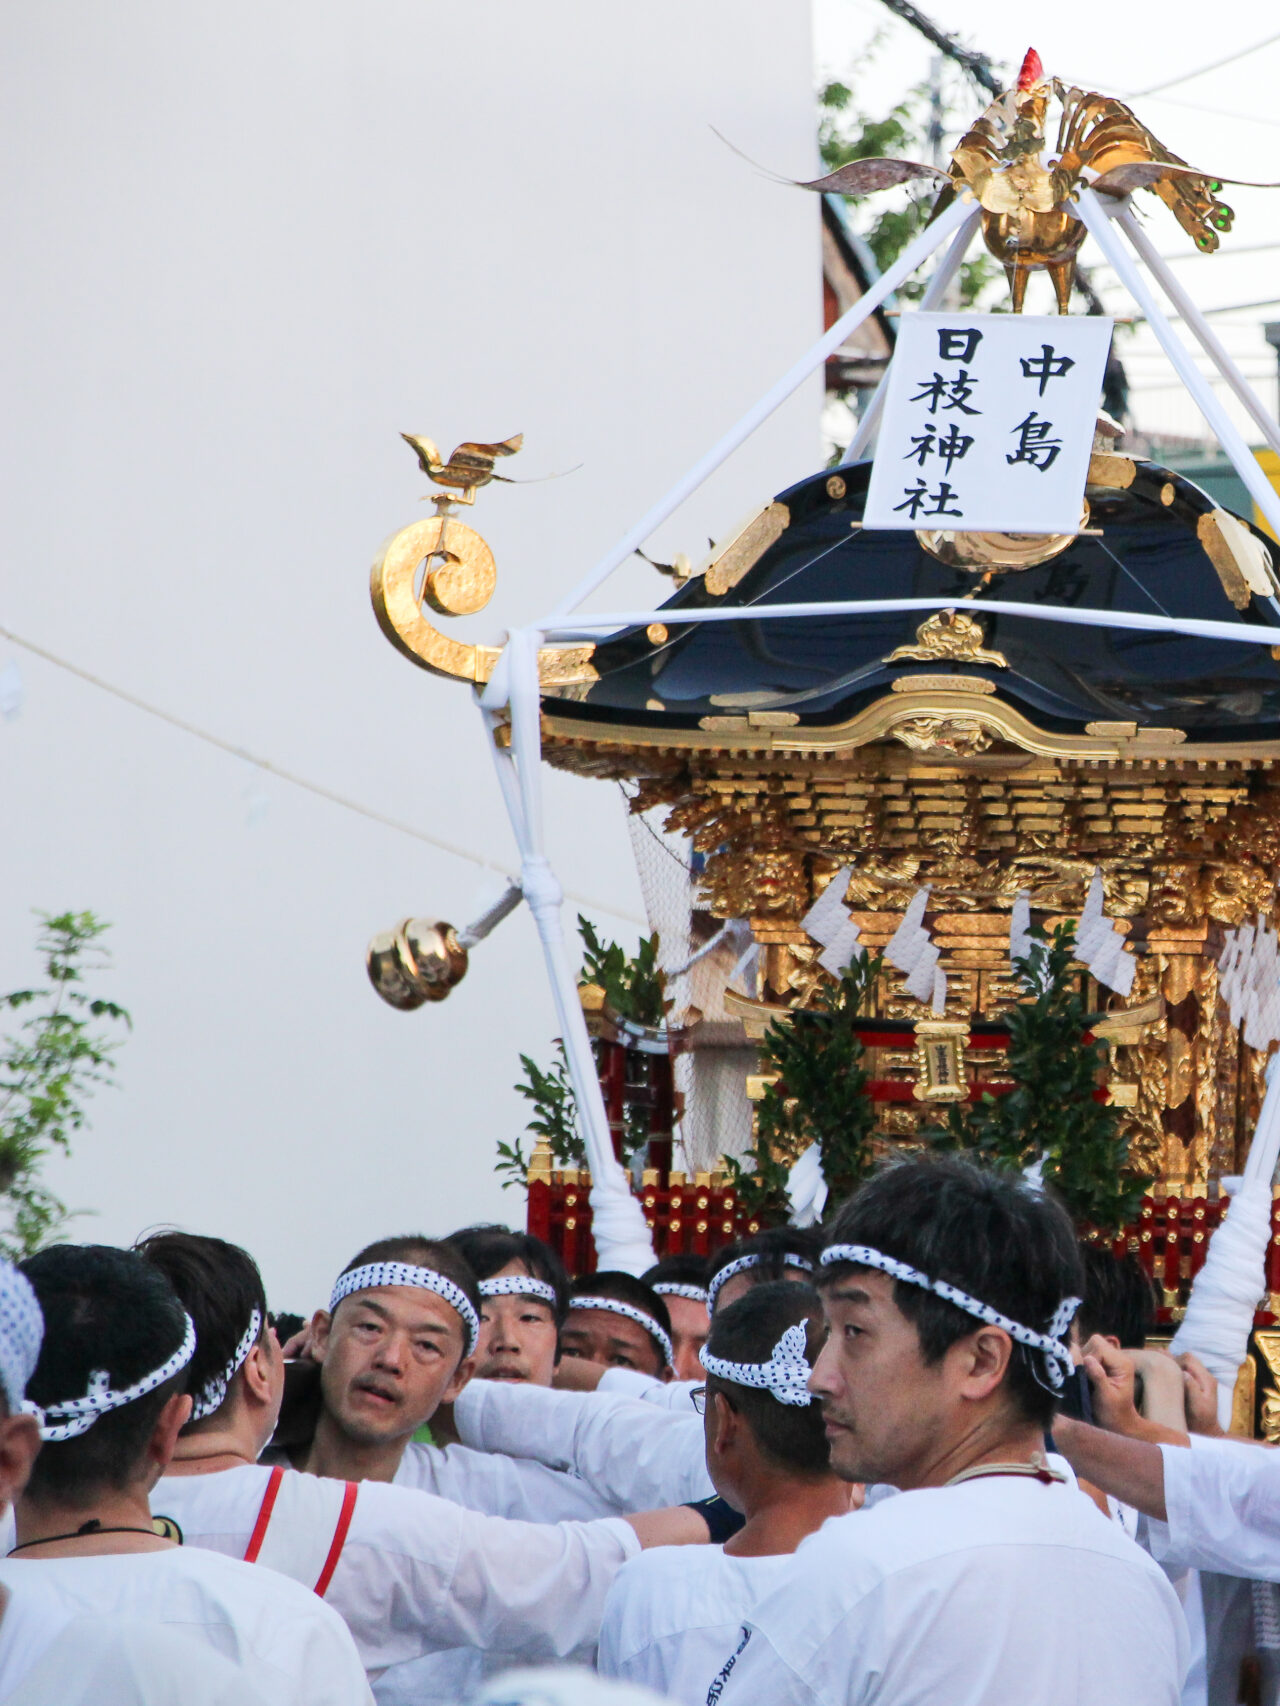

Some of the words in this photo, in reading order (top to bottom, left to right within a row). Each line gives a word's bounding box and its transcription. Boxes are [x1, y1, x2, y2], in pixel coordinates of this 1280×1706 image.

[893, 328, 983, 520] 日枝神社
[1004, 344, 1076, 472] 中島
